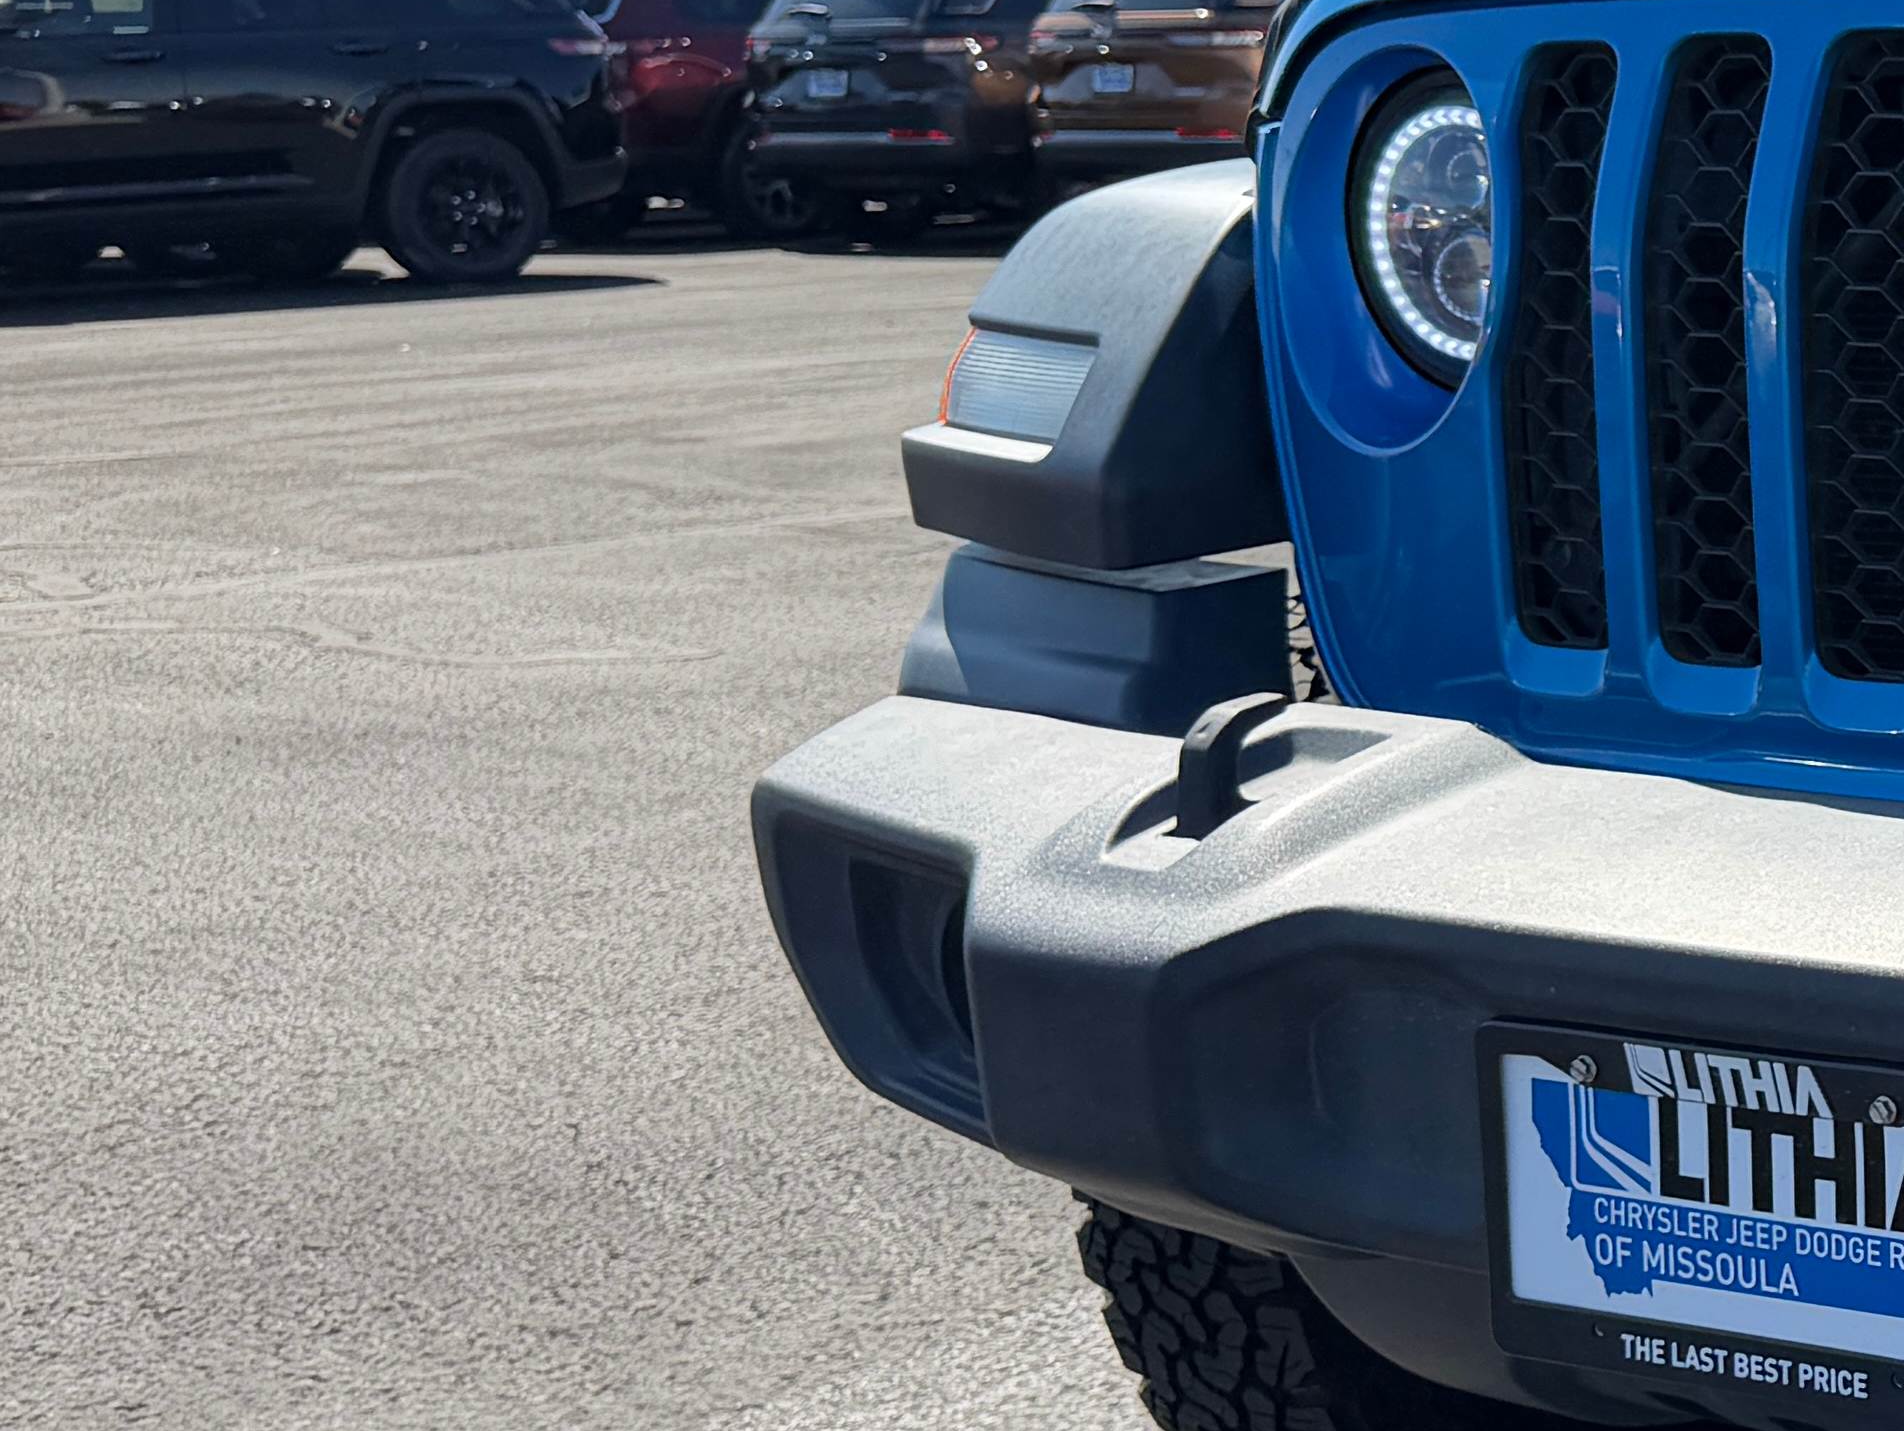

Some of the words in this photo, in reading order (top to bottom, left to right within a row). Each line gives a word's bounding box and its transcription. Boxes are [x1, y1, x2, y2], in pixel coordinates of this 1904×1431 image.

[1668, 1048, 1833, 1119] LITHIA
[1593, 1196, 1719, 1242] CHRYSLER
[1726, 1217, 1787, 1252] JEEP
[1795, 1227, 1882, 1267] DODGE
[1595, 1232, 1632, 1268] OF
[1642, 1239, 1799, 1297] MISSOULA
[1620, 1332, 1666, 1366] THE
[1670, 1341, 1728, 1374] LAST
[1733, 1351, 1793, 1386] BEST
[1798, 1362, 1869, 1399] PRICE
